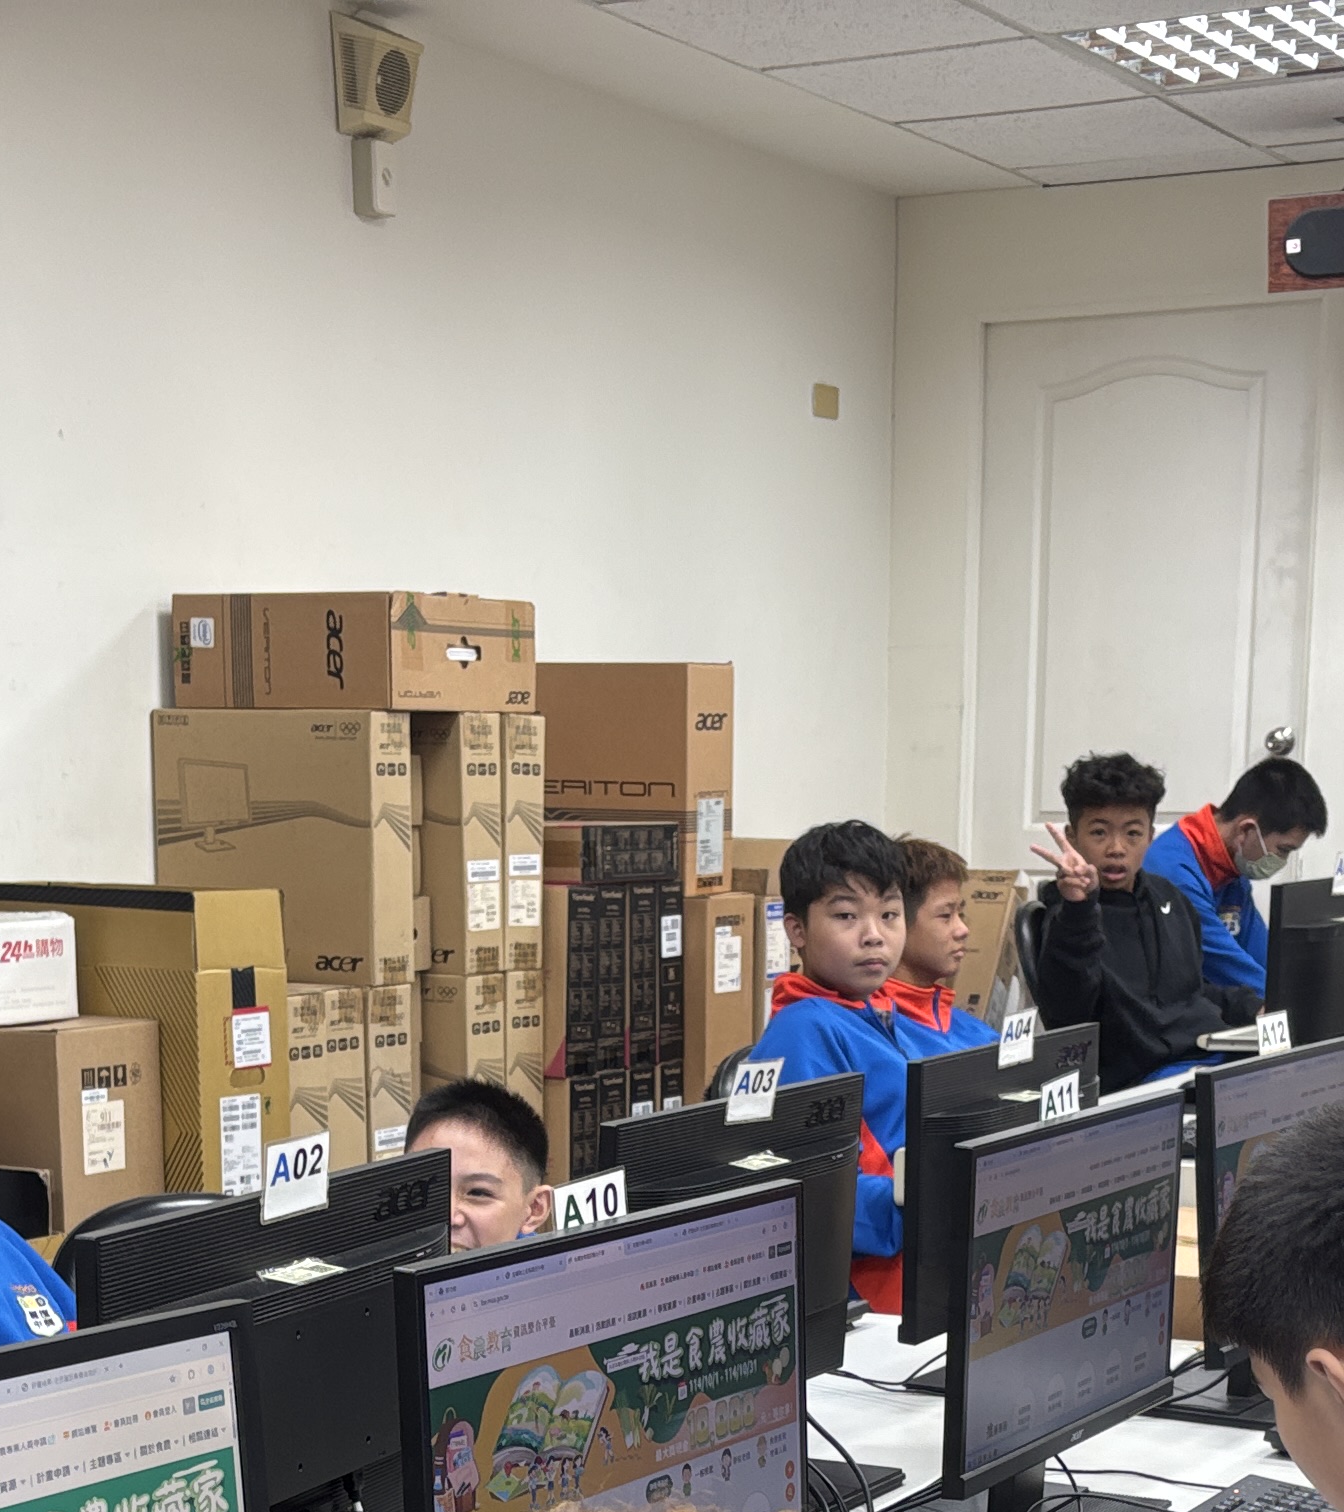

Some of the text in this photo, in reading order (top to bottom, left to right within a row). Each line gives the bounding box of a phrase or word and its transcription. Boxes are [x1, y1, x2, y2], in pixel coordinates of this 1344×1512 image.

[325, 608, 346, 691] acer
[695, 712, 728, 731] acer
[543, 779, 676, 798] ERITON
[0, 939, 35, 964] 24h
[35, 937, 64, 958] 購物
[315, 954, 364, 973] acer
[1003, 1015, 1033, 1043] A04
[1261, 1019, 1288, 1048] A12
[733, 1068, 776, 1097] A03
[1045, 1080, 1074, 1120] A11
[270, 1143, 325, 1187] A02
[561, 1182, 619, 1231] A10
[457, 1325, 513, 1364] 食農教育
[638, 1294, 792, 1384] 我是食農收藏家
